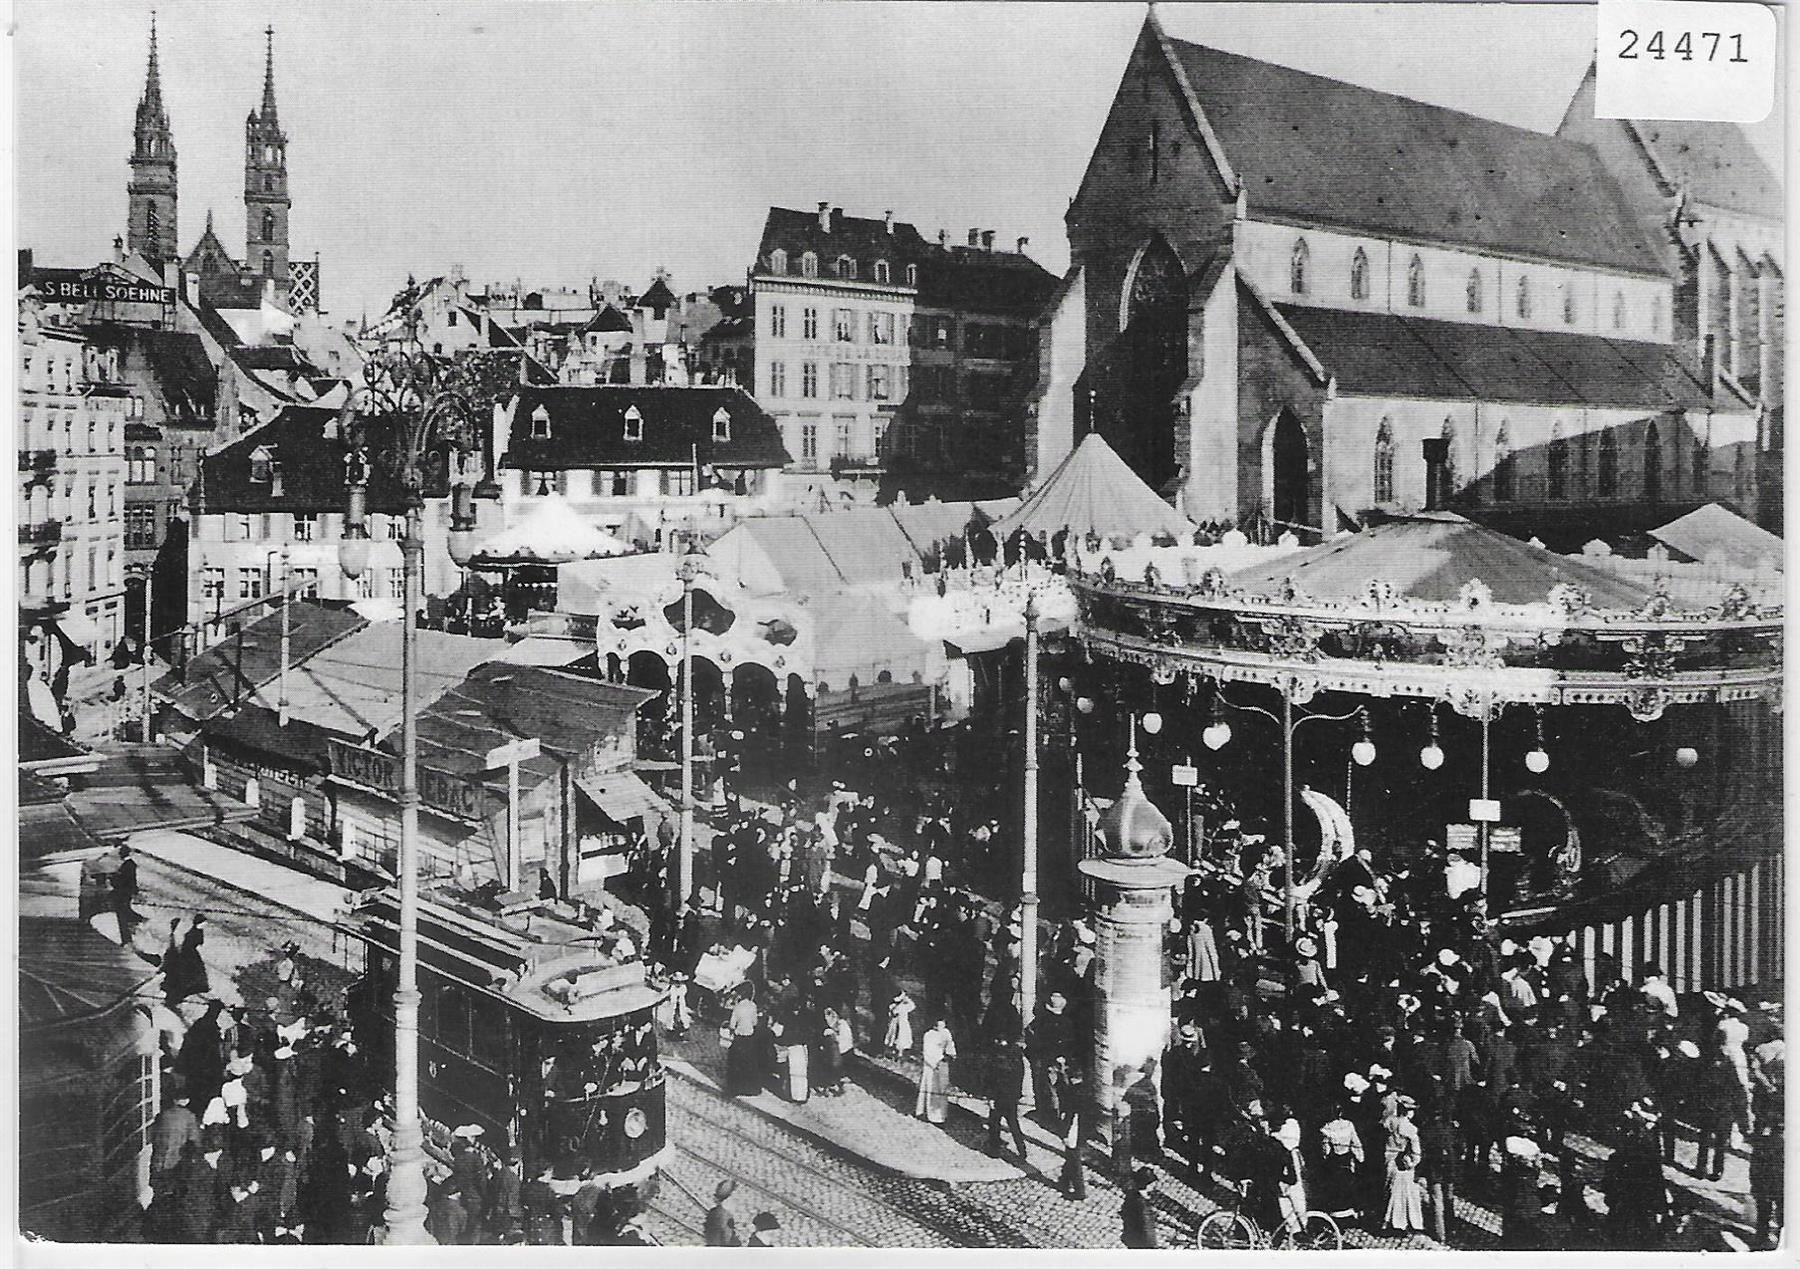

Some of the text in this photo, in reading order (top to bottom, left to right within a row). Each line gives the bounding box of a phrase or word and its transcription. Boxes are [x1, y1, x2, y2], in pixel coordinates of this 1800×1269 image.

[44, 281, 56, 296] S
[105, 285, 170, 302] SOEHNE
[334, 744, 394, 789] VICTOR
